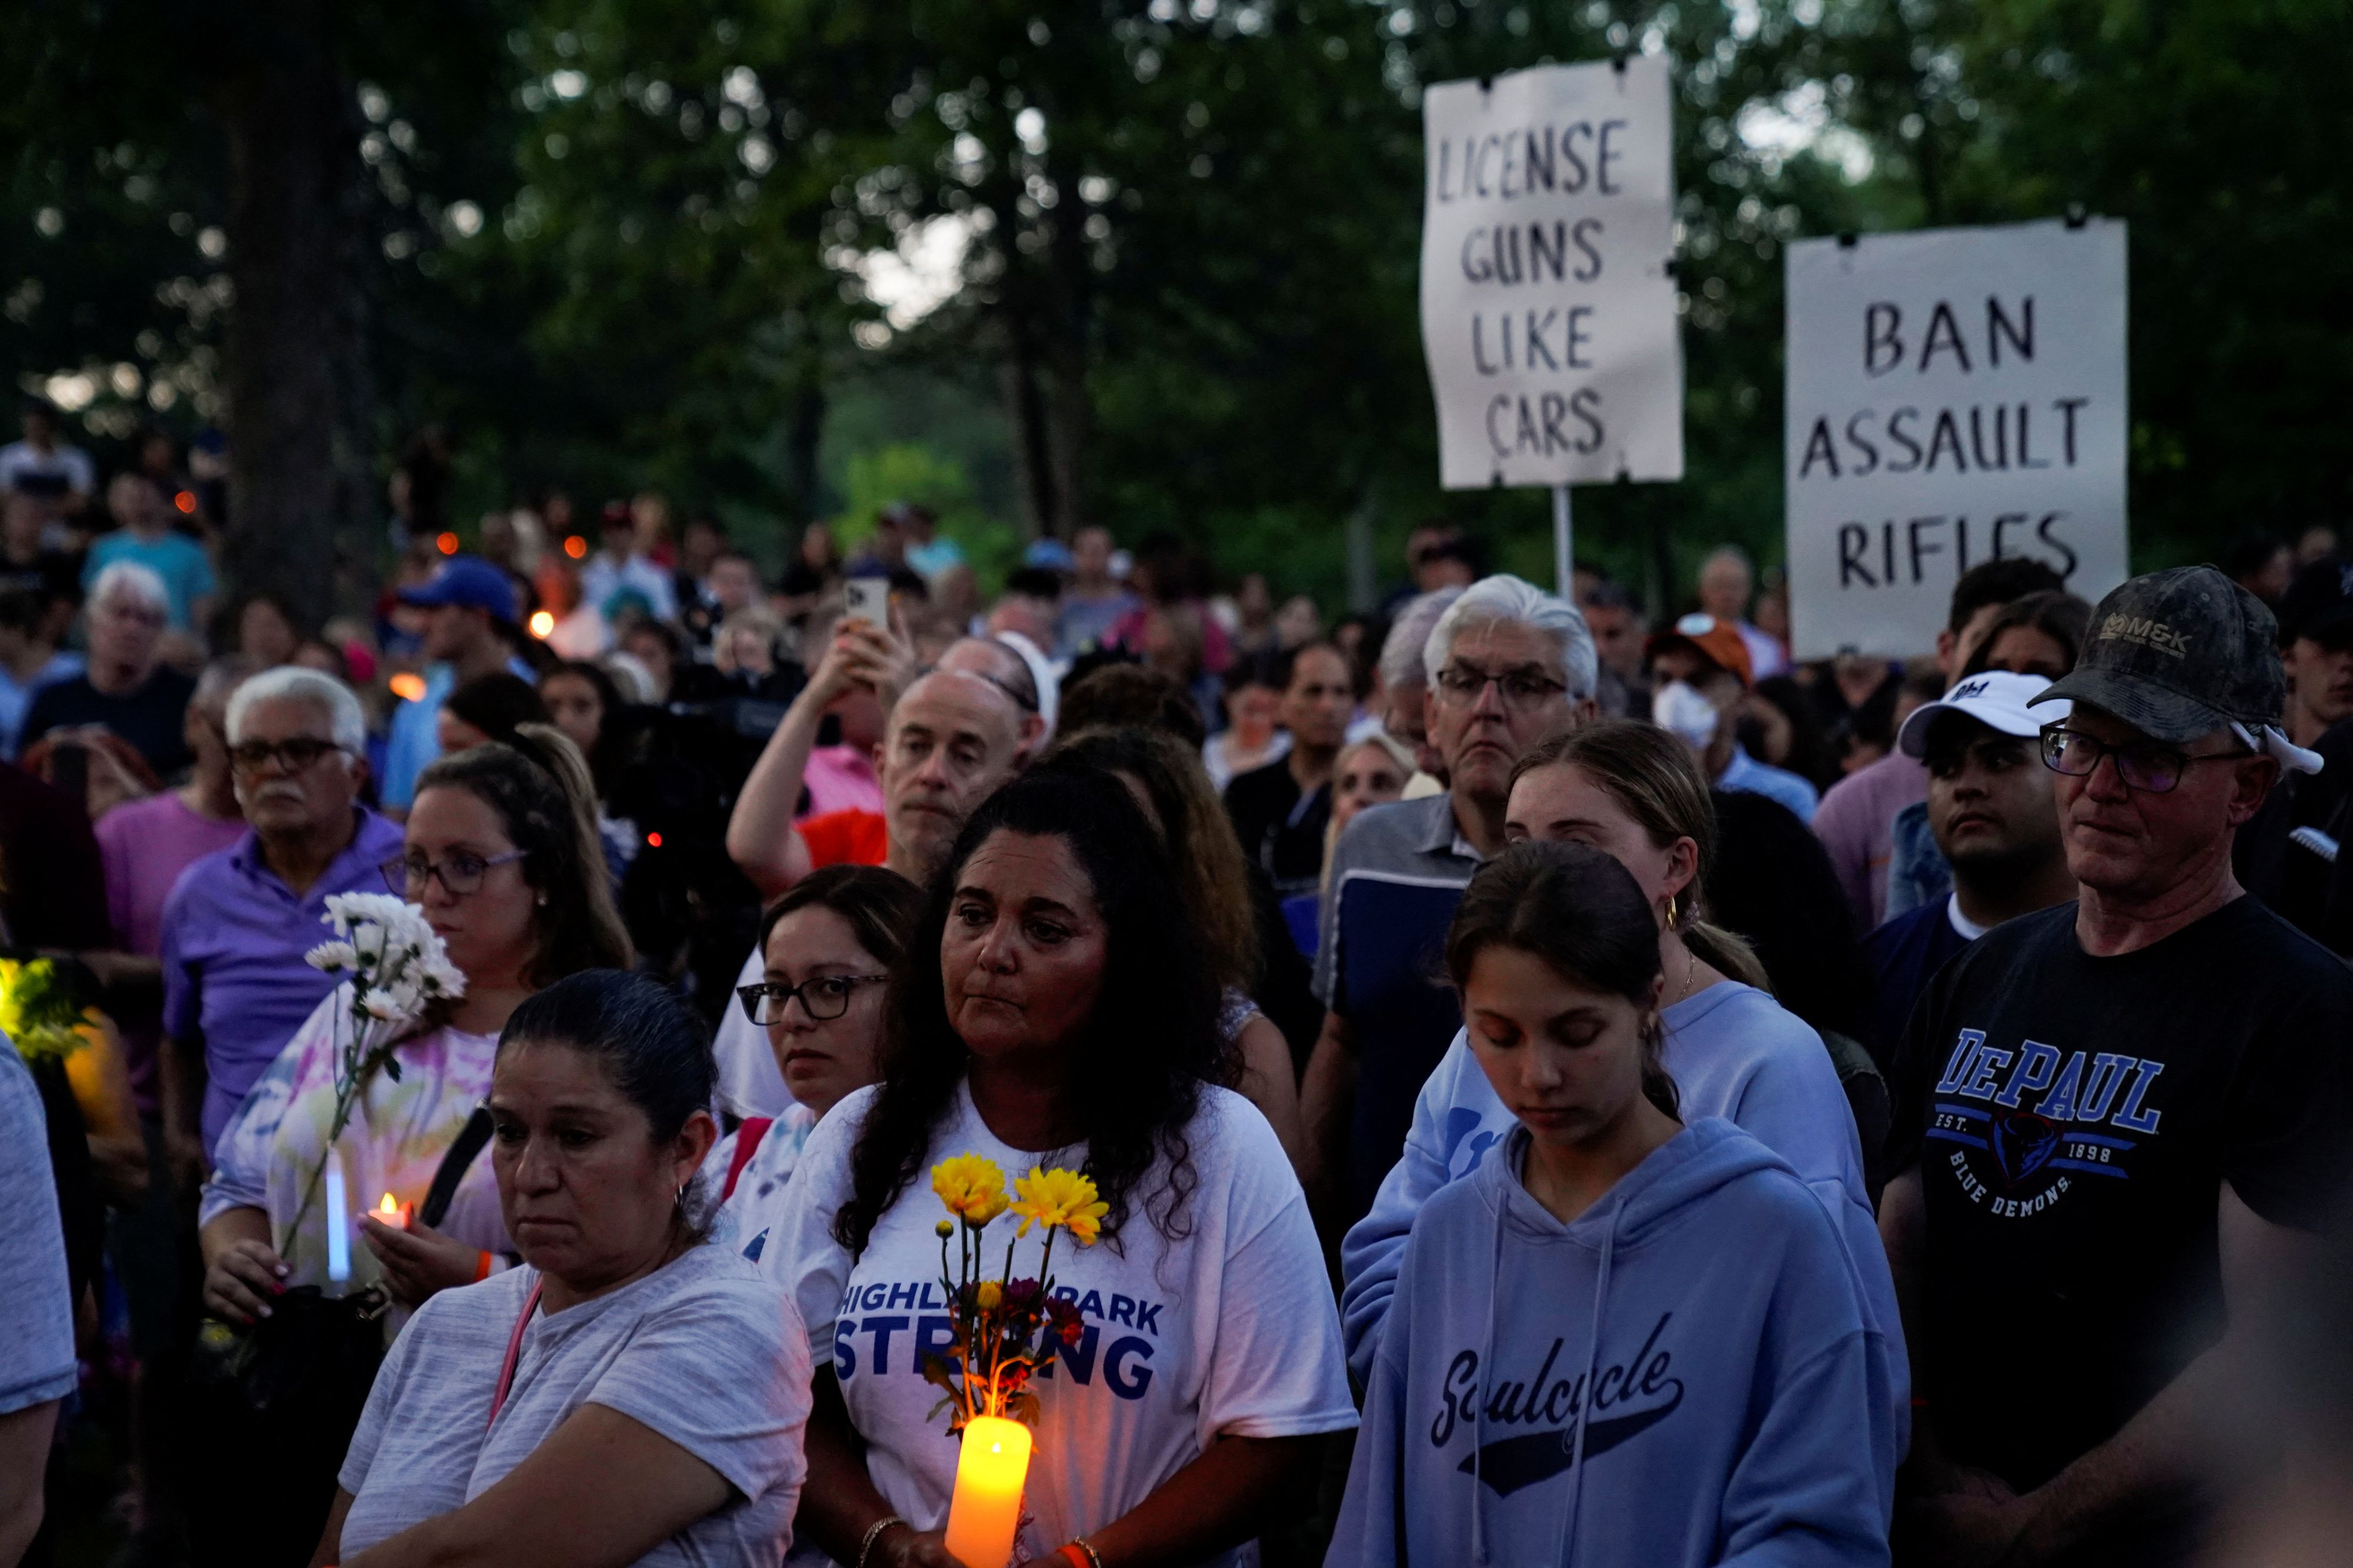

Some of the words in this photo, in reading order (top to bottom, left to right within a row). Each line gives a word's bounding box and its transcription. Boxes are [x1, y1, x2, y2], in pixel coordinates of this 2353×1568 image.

[1437, 119, 1629, 202] LICENSE
[1461, 216, 1605, 286] GUNS
[1472, 305, 1594, 376] LIKE
[1863, 293, 2035, 378] BAN
[1485, 386, 1605, 459] CARS
[1798, 396, 2091, 480] ASSAULT
[1935, 1113, 1967, 1132] EST.
[2068, 1143, 2112, 1163] 1898
[1949, 1150, 1988, 1203] BLUE
[1990, 1175, 2070, 1217] DEMONS
[834, 1315, 1155, 1400] STRNG
